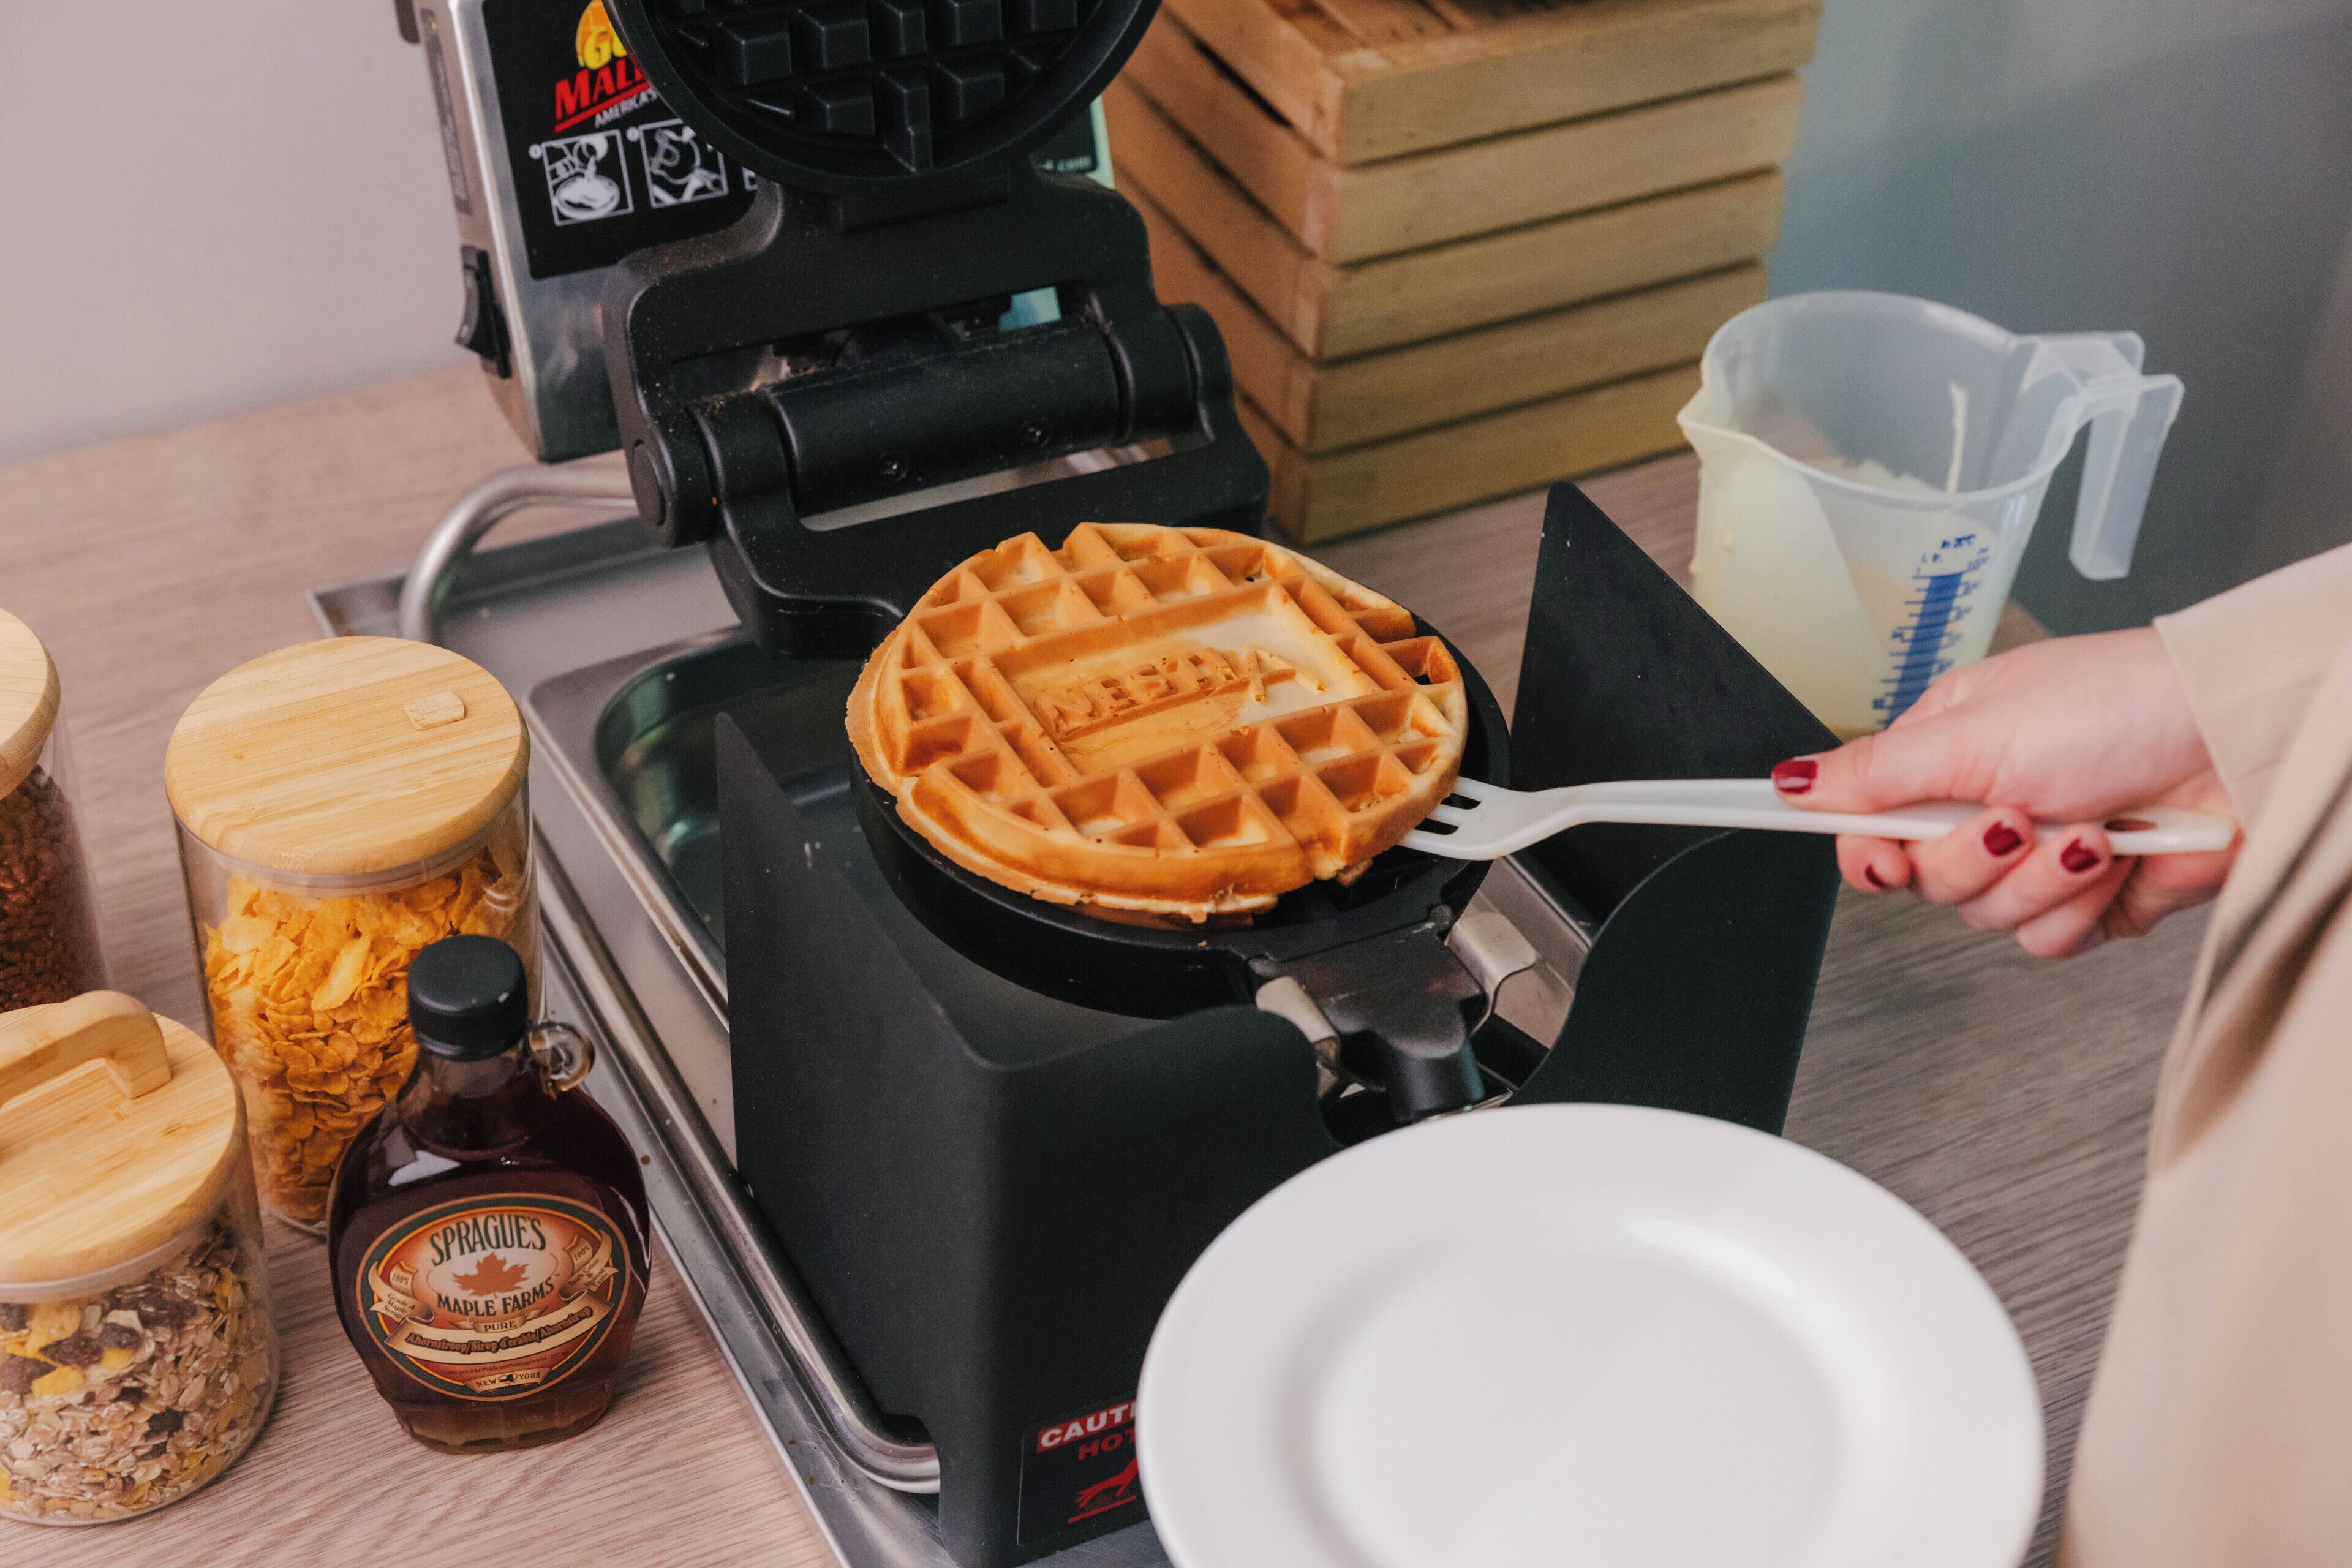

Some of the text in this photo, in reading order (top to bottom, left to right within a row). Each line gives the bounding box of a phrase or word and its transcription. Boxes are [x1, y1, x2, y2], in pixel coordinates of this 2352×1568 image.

[429, 1214, 546, 1267] SPRAGUE'S
[391, 1273, 409, 1286] 100%
[387, 1292, 409, 1306] Grade
[437, 1276, 555, 1317] MAPLE FARMS
[484, 1320, 518, 1332] PURE
[476, 1371, 541, 1389] NEW YORK
